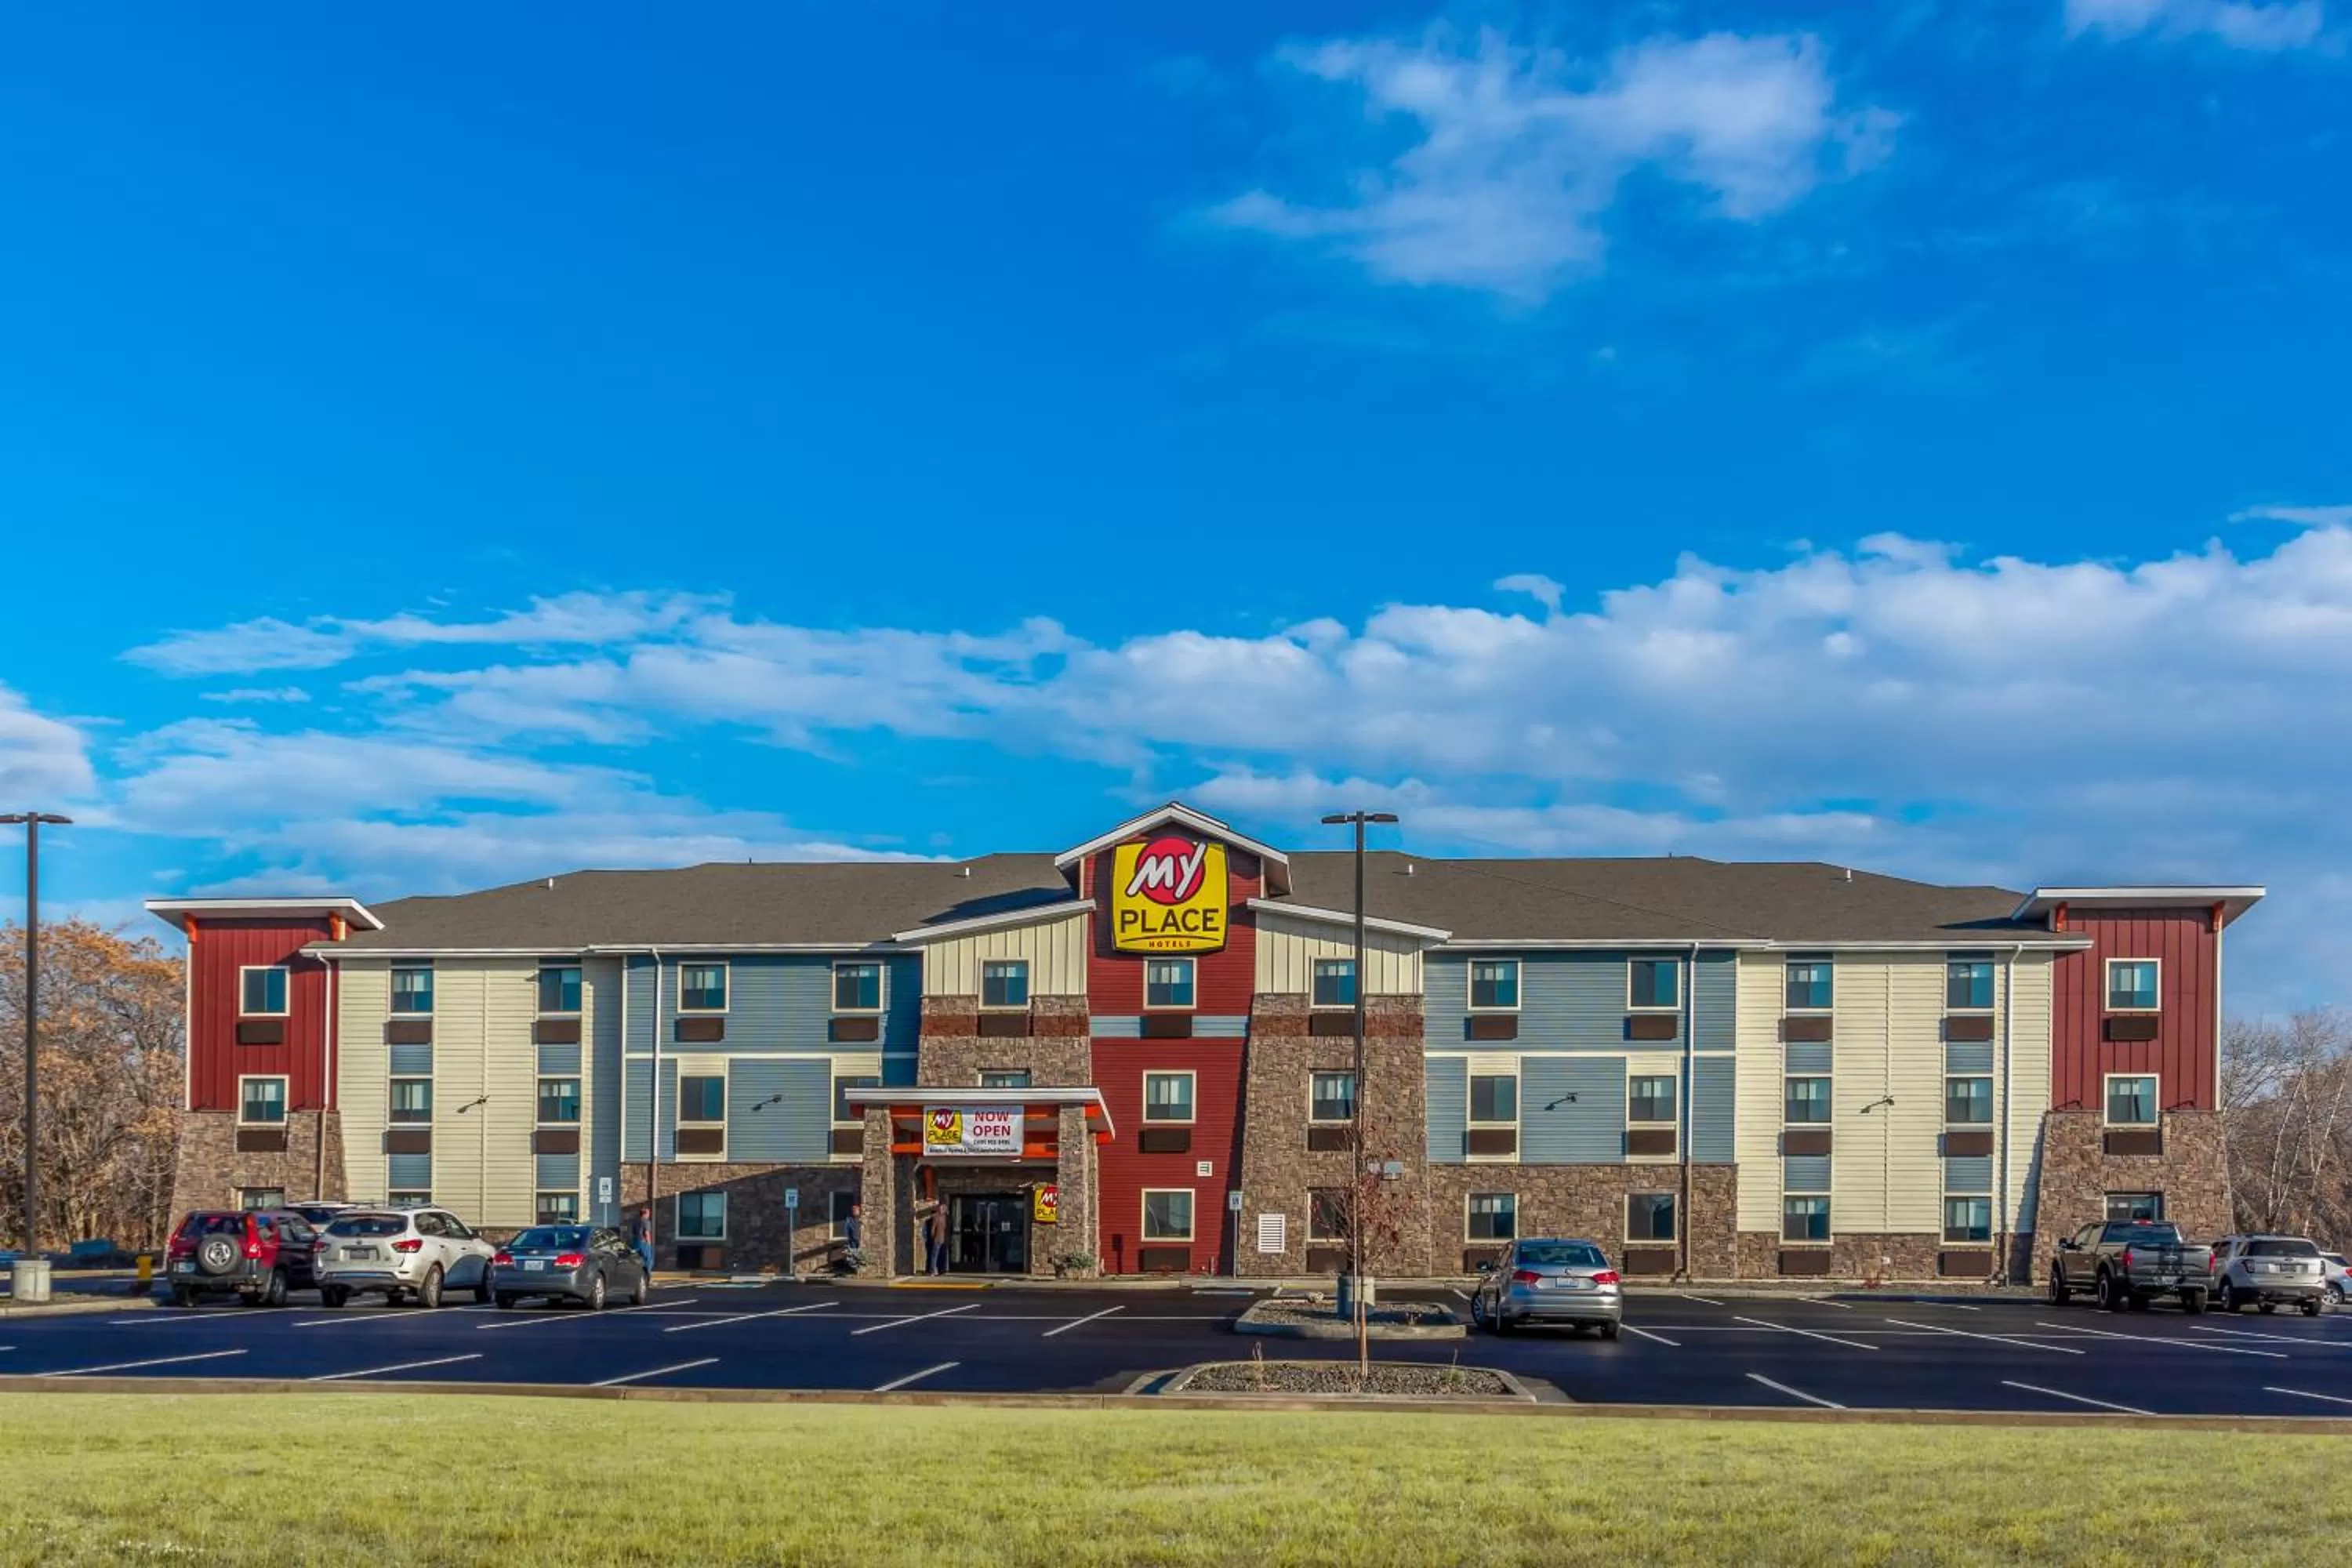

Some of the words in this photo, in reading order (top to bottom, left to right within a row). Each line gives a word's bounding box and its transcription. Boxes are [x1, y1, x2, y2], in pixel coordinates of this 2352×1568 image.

[1120, 909, 1219, 933] PLACE
[975, 1111, 1009, 1122] NOW
[928, 1130, 959, 1140] PLACE
[973, 1125, 1011, 1136] OPEN
